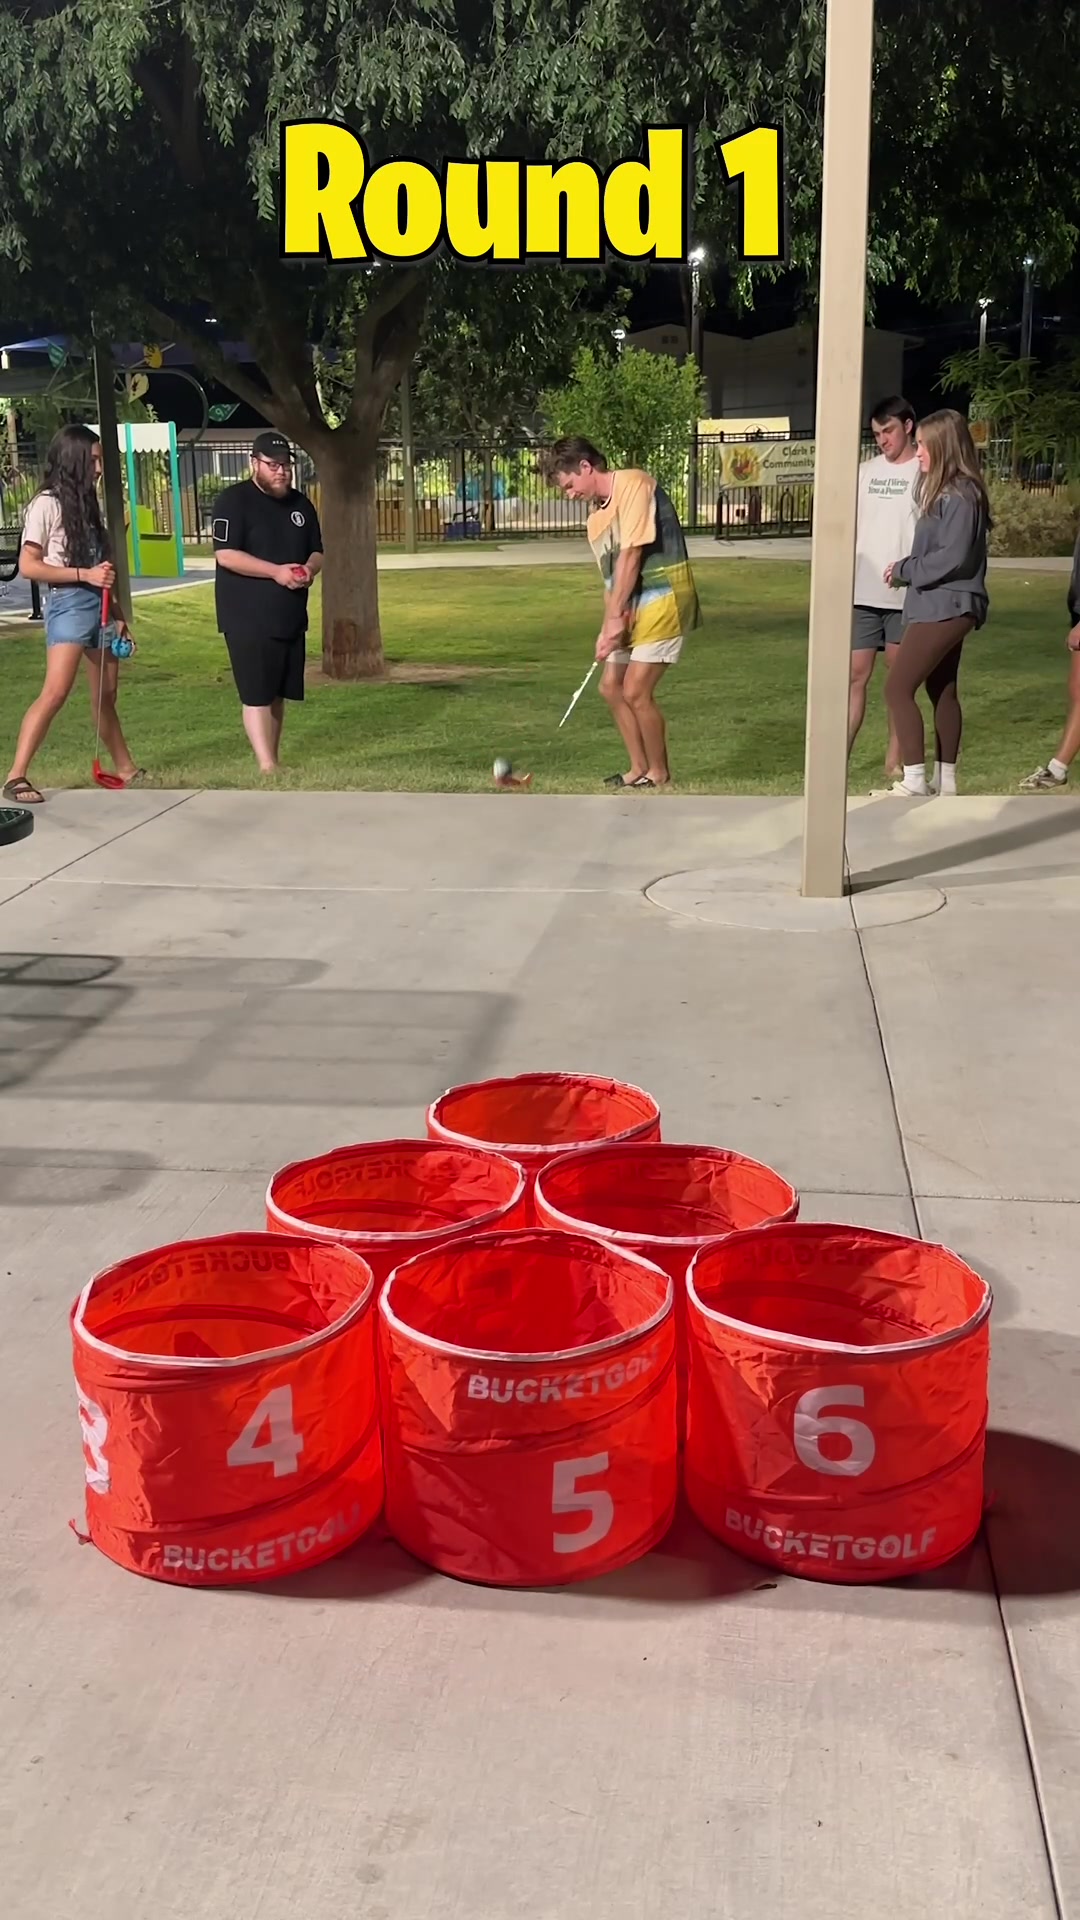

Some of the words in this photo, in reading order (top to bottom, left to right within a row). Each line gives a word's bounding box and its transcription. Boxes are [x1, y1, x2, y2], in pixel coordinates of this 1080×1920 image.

[763, 458, 815, 469] Community
[782, 446, 807, 456] Clark
[226, 1384, 304, 1478] 4
[793, 1384, 875, 1477] 6
[551, 1451, 614, 1554] 5
[725, 1507, 938, 1561] BUCKETGOLF
